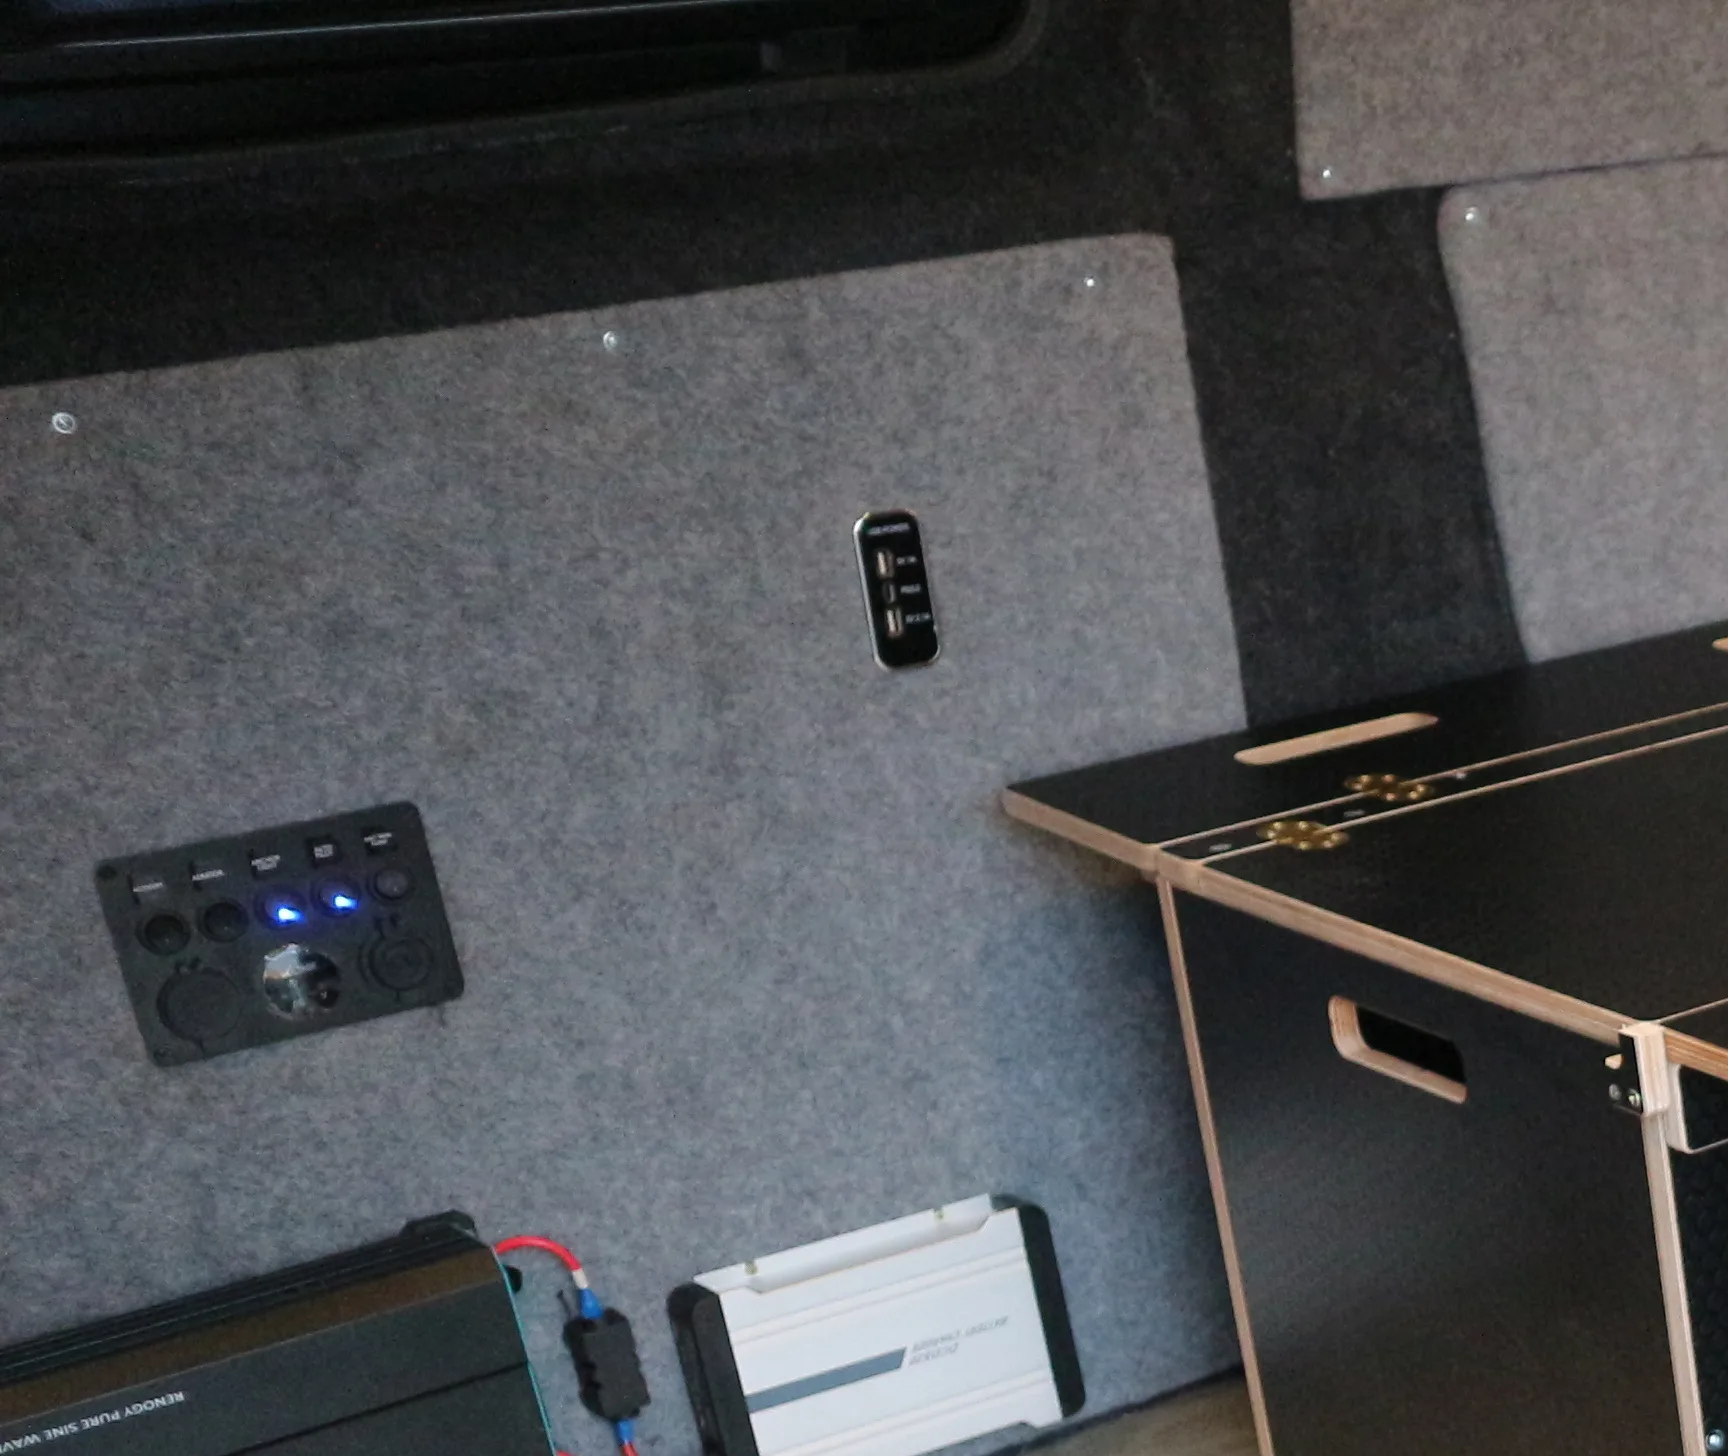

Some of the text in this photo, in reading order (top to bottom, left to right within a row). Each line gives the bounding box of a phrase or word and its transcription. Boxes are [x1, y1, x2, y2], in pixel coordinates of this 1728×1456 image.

[0, 1391, 185, 1454] RENOGY PURE SINE WAV
